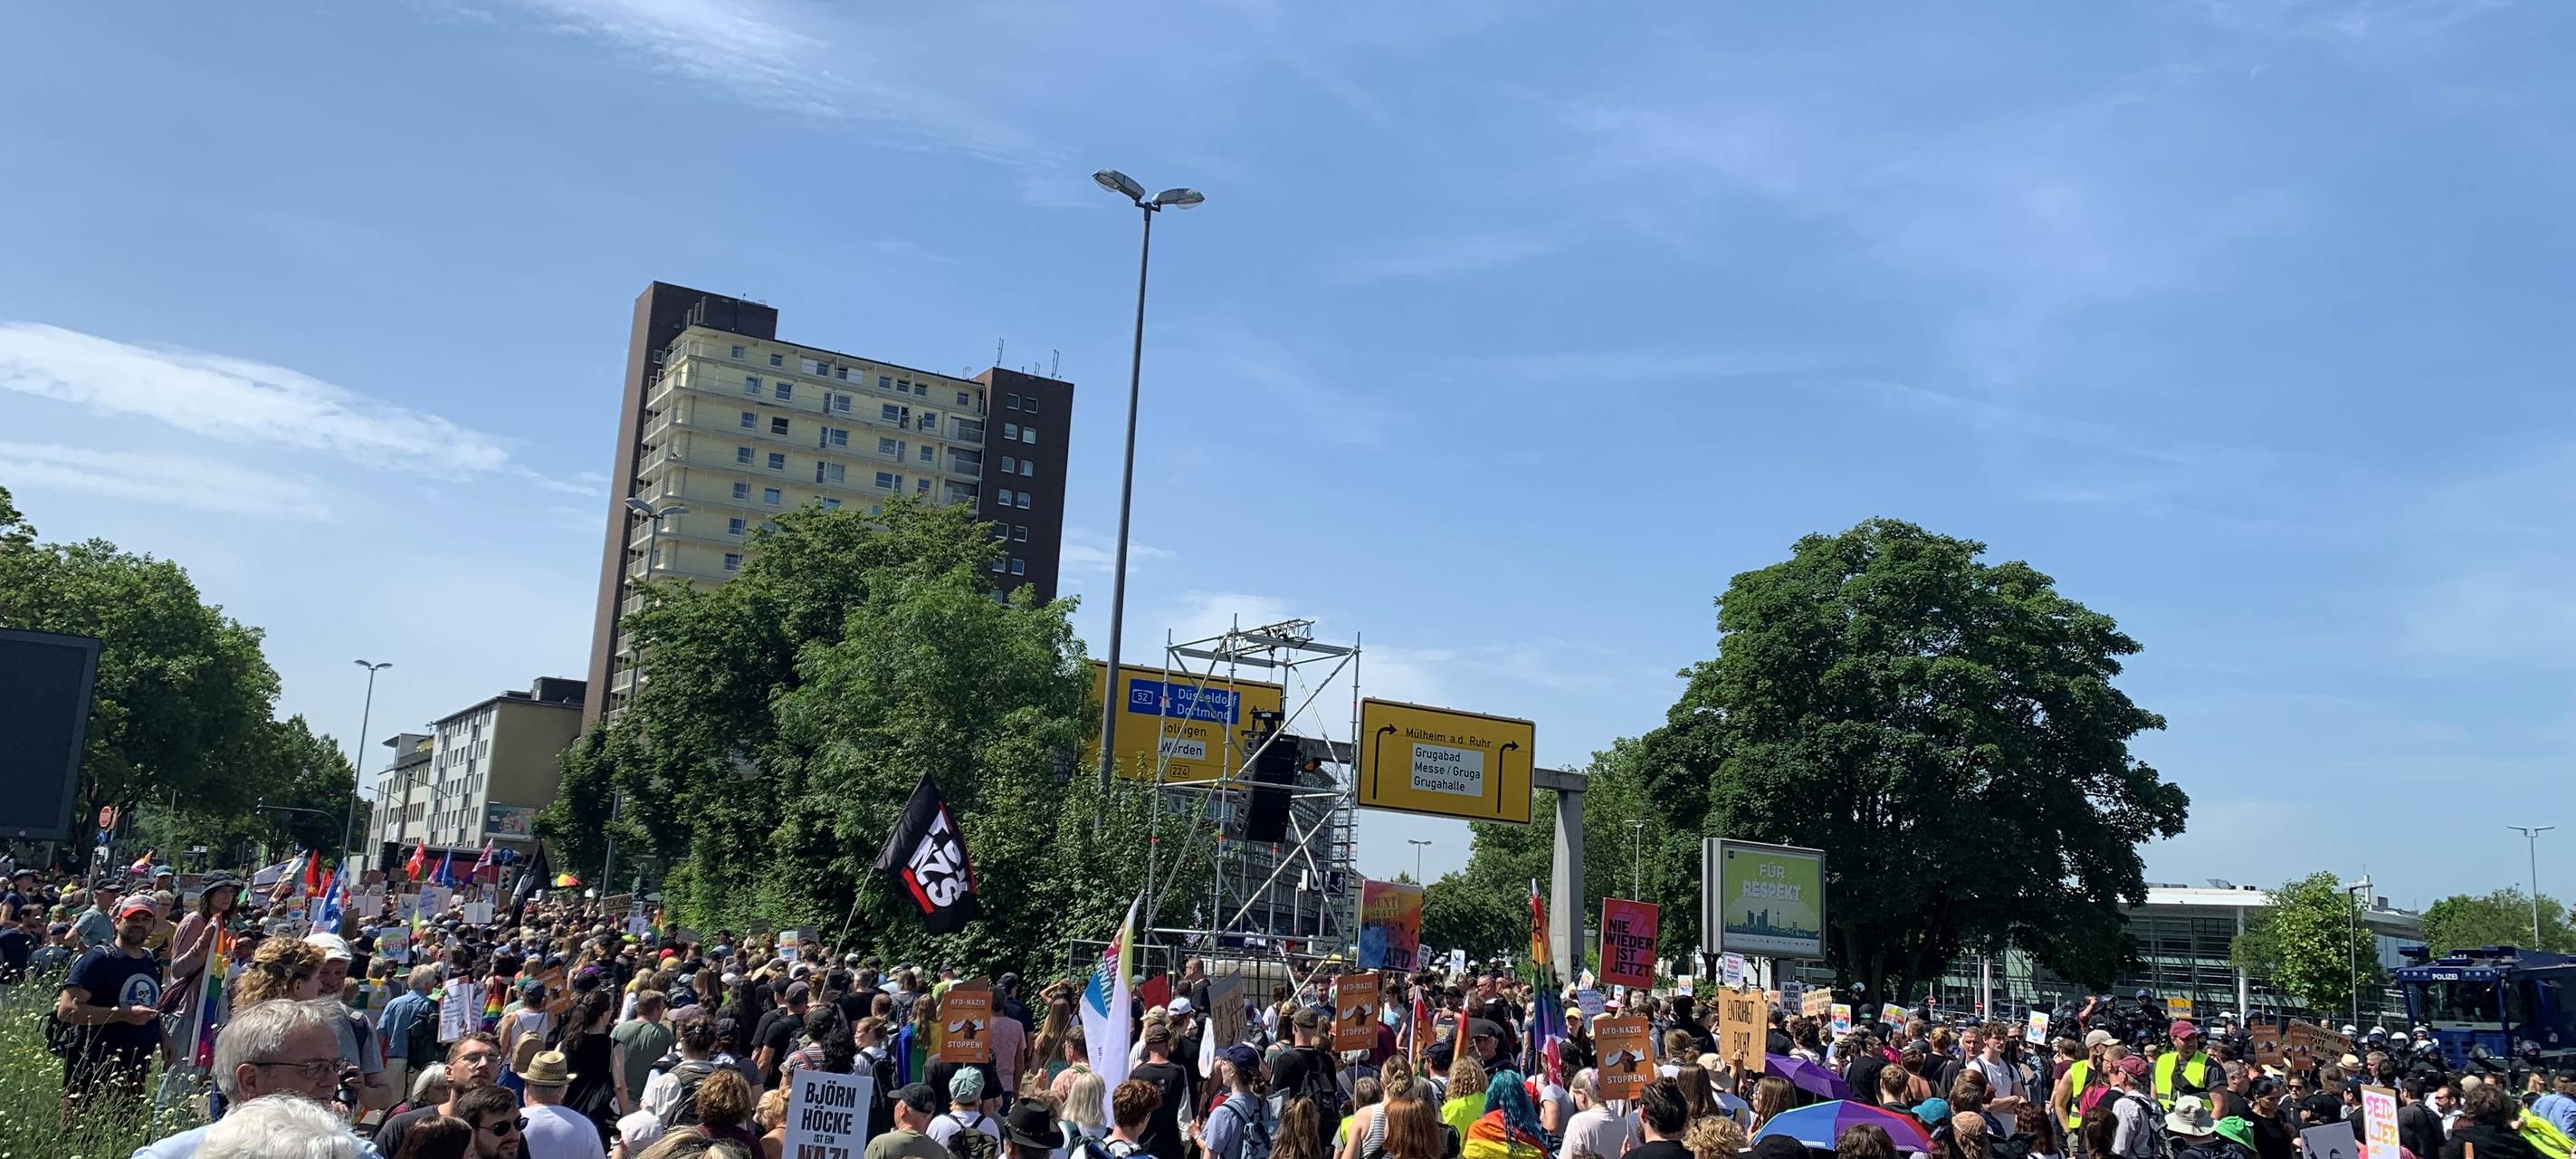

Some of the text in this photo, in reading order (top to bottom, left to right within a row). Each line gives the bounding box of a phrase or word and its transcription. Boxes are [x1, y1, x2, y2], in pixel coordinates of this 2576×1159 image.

[1138, 693, 1148, 702] 52
[1178, 688, 1237, 706] Düsseldof
[1163, 722, 1207, 738] olingen
[1406, 727, 1445, 742] Mülheim
[1469, 736, 1492, 748] Ruhr
[1415, 747, 1461, 761] Grugabad
[1172, 767, 1188, 777] 224
[1415, 761, 1445, 775] Messe
[1453, 766, 1481, 781] Gruga
[1414, 776, 1465, 791] Grugahalle
[1759, 862, 1785, 878] FÜR
[1742, 880, 1801, 901] RESPEKT
[1608, 918, 1630, 934] NIE
[1604, 933, 1654, 951] WIEDER
[1615, 947, 1636, 962] IST
[1610, 961, 1652, 977] JETZT
[1341, 1028, 1372, 1037] STOPPEN!
[1602, 1026, 1642, 1035] AFD-NAZIS
[947, 1040, 983, 1049] STOPPEN!
[1607, 1074, 1647, 1085] STOPPEN!
[805, 1080, 857, 1108] BJÖRN
[2366, 1094, 2394, 1120] SEID
[801, 1105, 853, 1135] HÖCKE
[813, 1135, 835, 1145] IST EIN
[2369, 1120, 2397, 1146] LIEB
